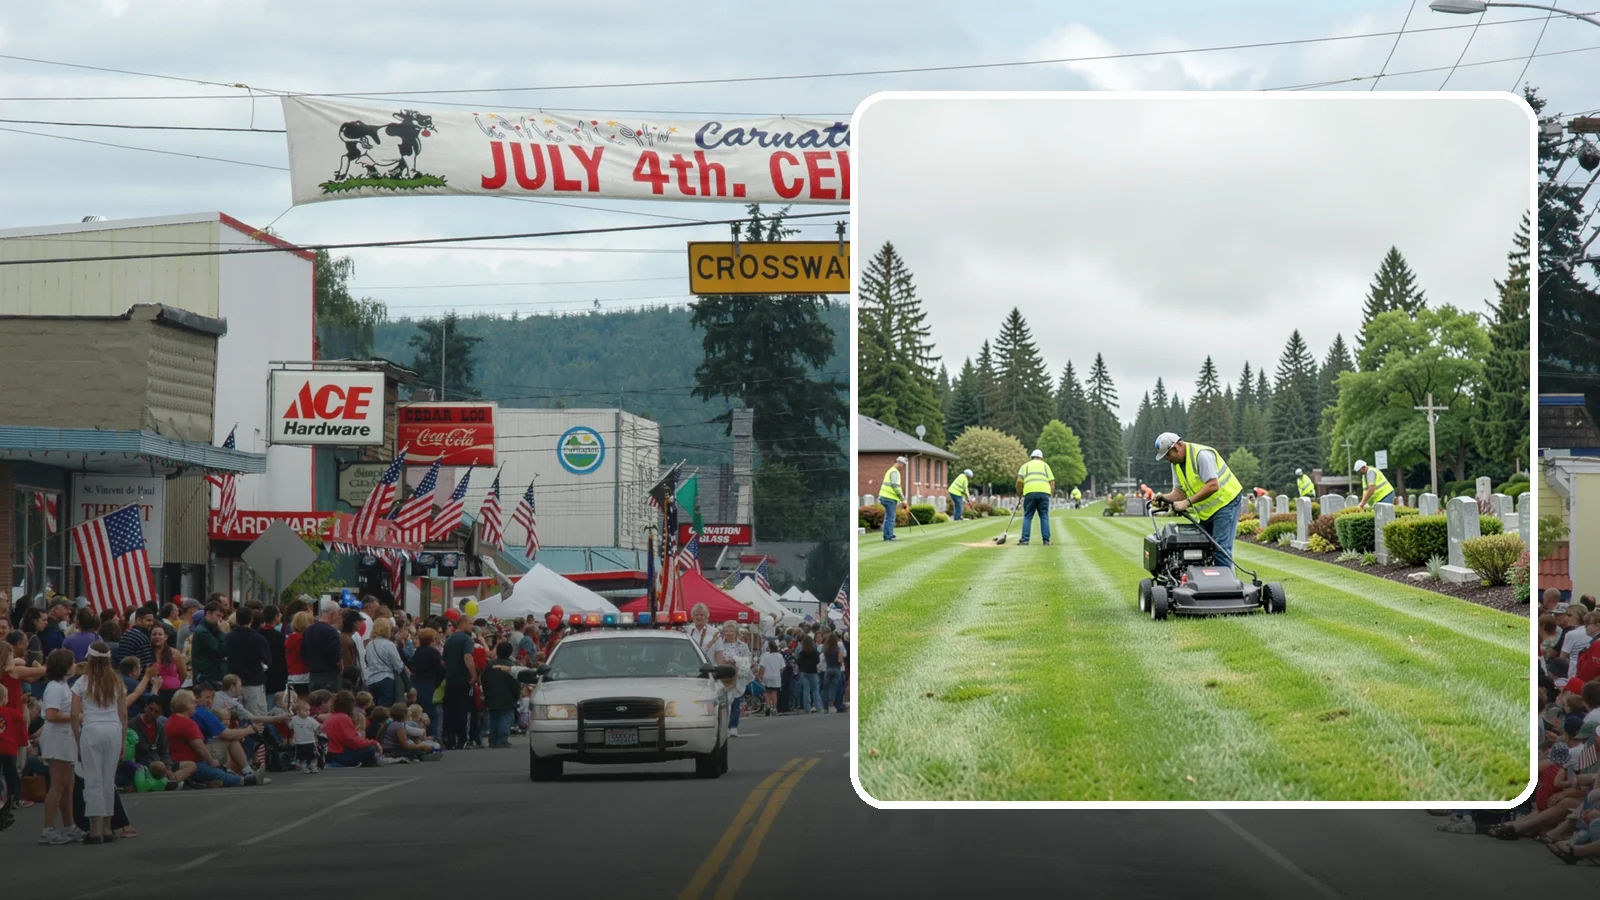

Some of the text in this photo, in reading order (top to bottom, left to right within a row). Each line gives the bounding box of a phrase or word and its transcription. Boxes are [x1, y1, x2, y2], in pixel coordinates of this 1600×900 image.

[481, 141, 605, 193] JULY
[632, 150, 747, 197] 4th.
[697, 254, 850, 280] CROSSWA
[283, 380, 373, 420] ACE
[406, 409, 452, 422] CEDAR
[283, 421, 370, 436] Hardware
[416, 428, 477, 447] Coca-Cola
[353, 467, 385, 480] Simpl
[96, 485, 124, 495] Vincent
[126, 486, 136, 495] de
[137, 486, 155, 495] Paul
[688, 526, 741, 535] CRNATION
[699, 535, 730, 543] GLASS
